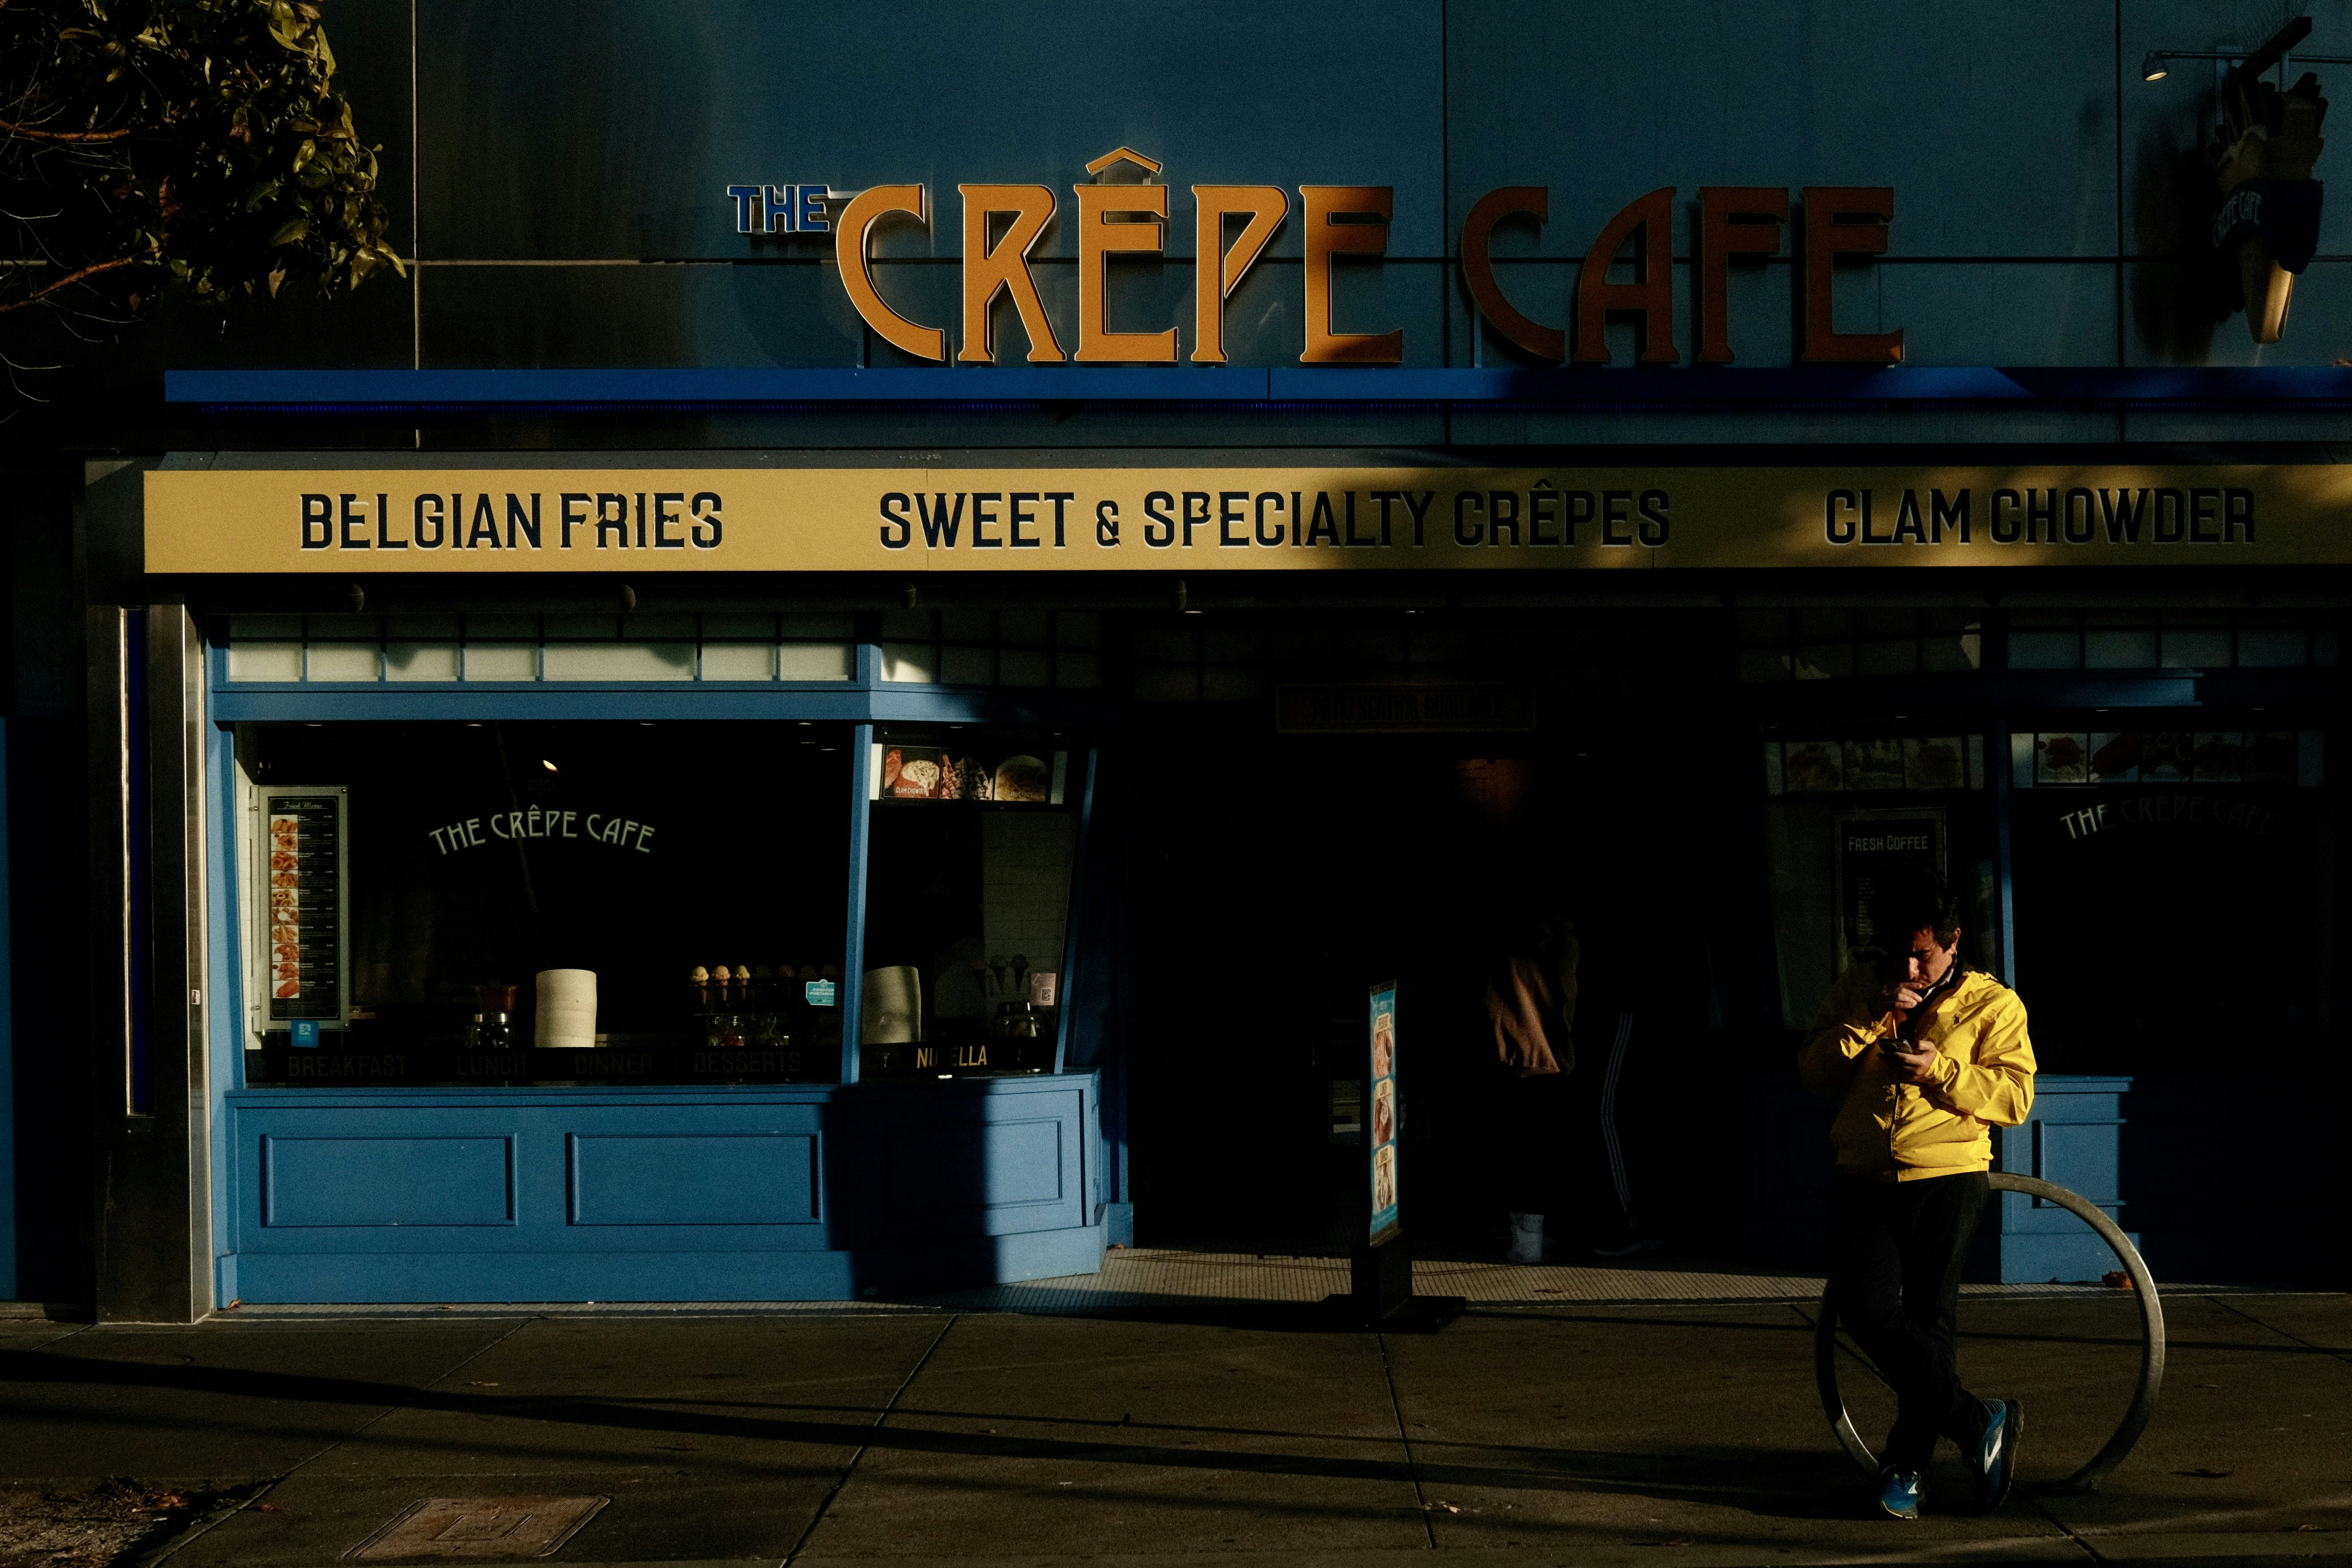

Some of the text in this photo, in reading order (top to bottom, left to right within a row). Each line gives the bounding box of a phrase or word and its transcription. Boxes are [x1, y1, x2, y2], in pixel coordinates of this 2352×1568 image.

[727, 146, 1905, 364] THE CRÊPE CAFE
[300, 492, 723, 551] BELGIAN FRIES
[879, 478, 1670, 549] SWEET & SPECIALTY CRÊPES
[1825, 488, 2255, 546] CLAM CHOWDER
[428, 804, 656, 856] THE CRÊPE CAFE
[1848, 835, 1884, 852] FRESH
[2058, 802, 2116, 841] THE
[287, 1050, 802, 1078] BREAKFAST LUNCH DINNER DESSERTS
[916, 1044, 988, 1069] NUELLA
